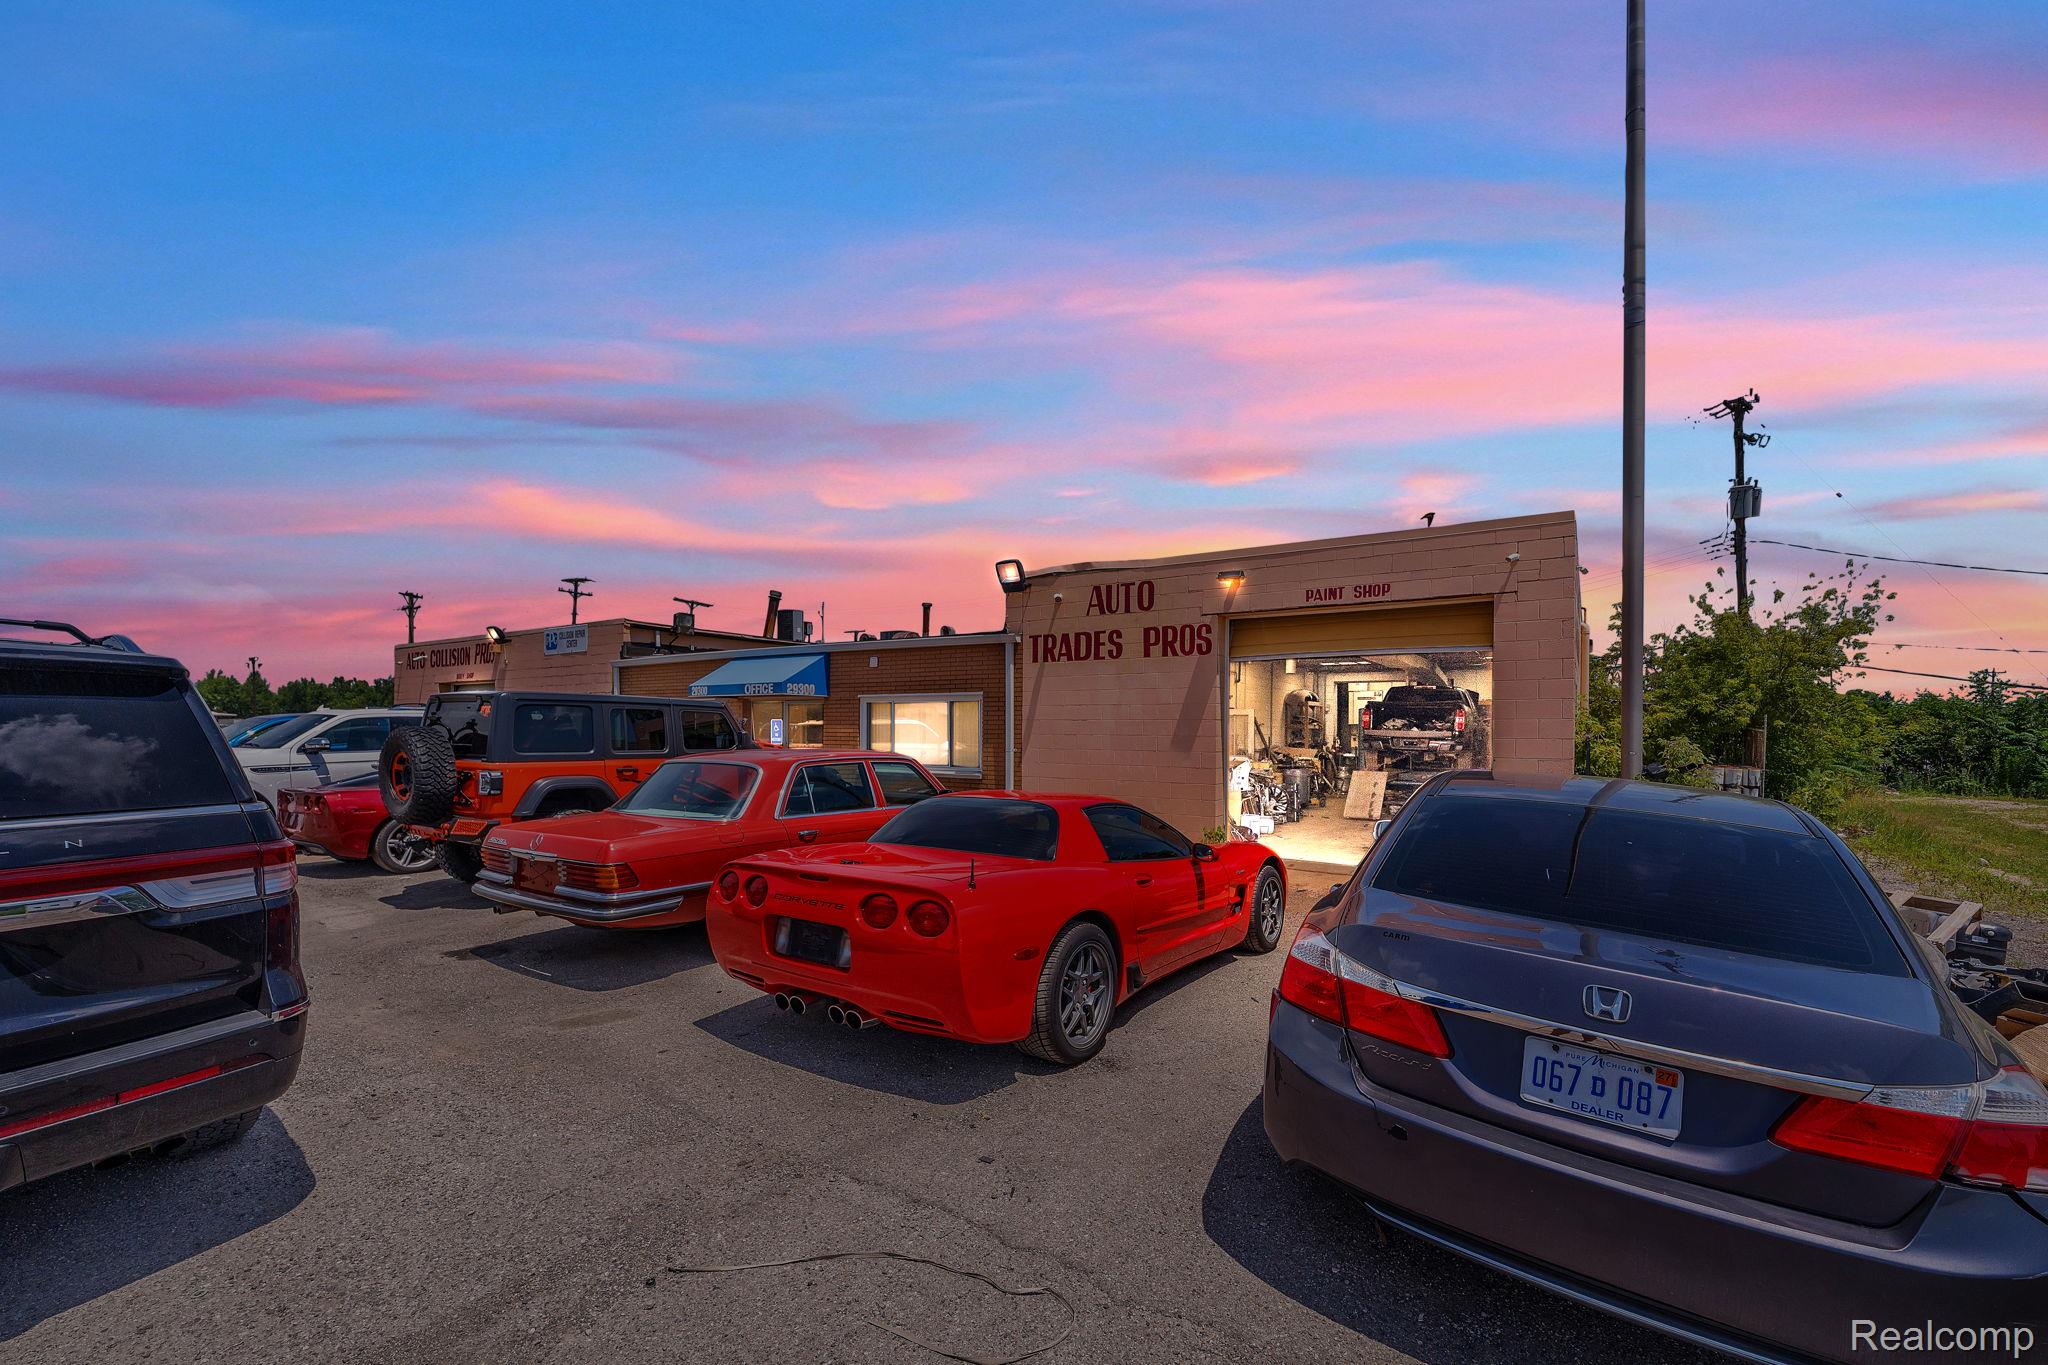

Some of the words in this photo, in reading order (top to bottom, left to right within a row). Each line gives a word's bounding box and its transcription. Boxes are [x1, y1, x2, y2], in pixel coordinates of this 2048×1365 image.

[1086, 580, 1155, 617] AUTO
[1305, 587, 1344, 602] PAINT
[1353, 583, 1392, 599] SHOP
[1029, 628, 1124, 664] TRADES
[1142, 623, 1213, 658] PROS
[406, 650, 426, 670] AUTO
[430, 646, 471, 668] COLLISION
[744, 683, 774, 695] OFFICE
[786, 683, 816, 695] 29300
[1565, 1052, 1586, 1062] PURE
[1532, 1056, 1582, 1097] 067
[1617, 1076, 1673, 1120] 087
[1571, 1100, 1625, 1122] DEALER
